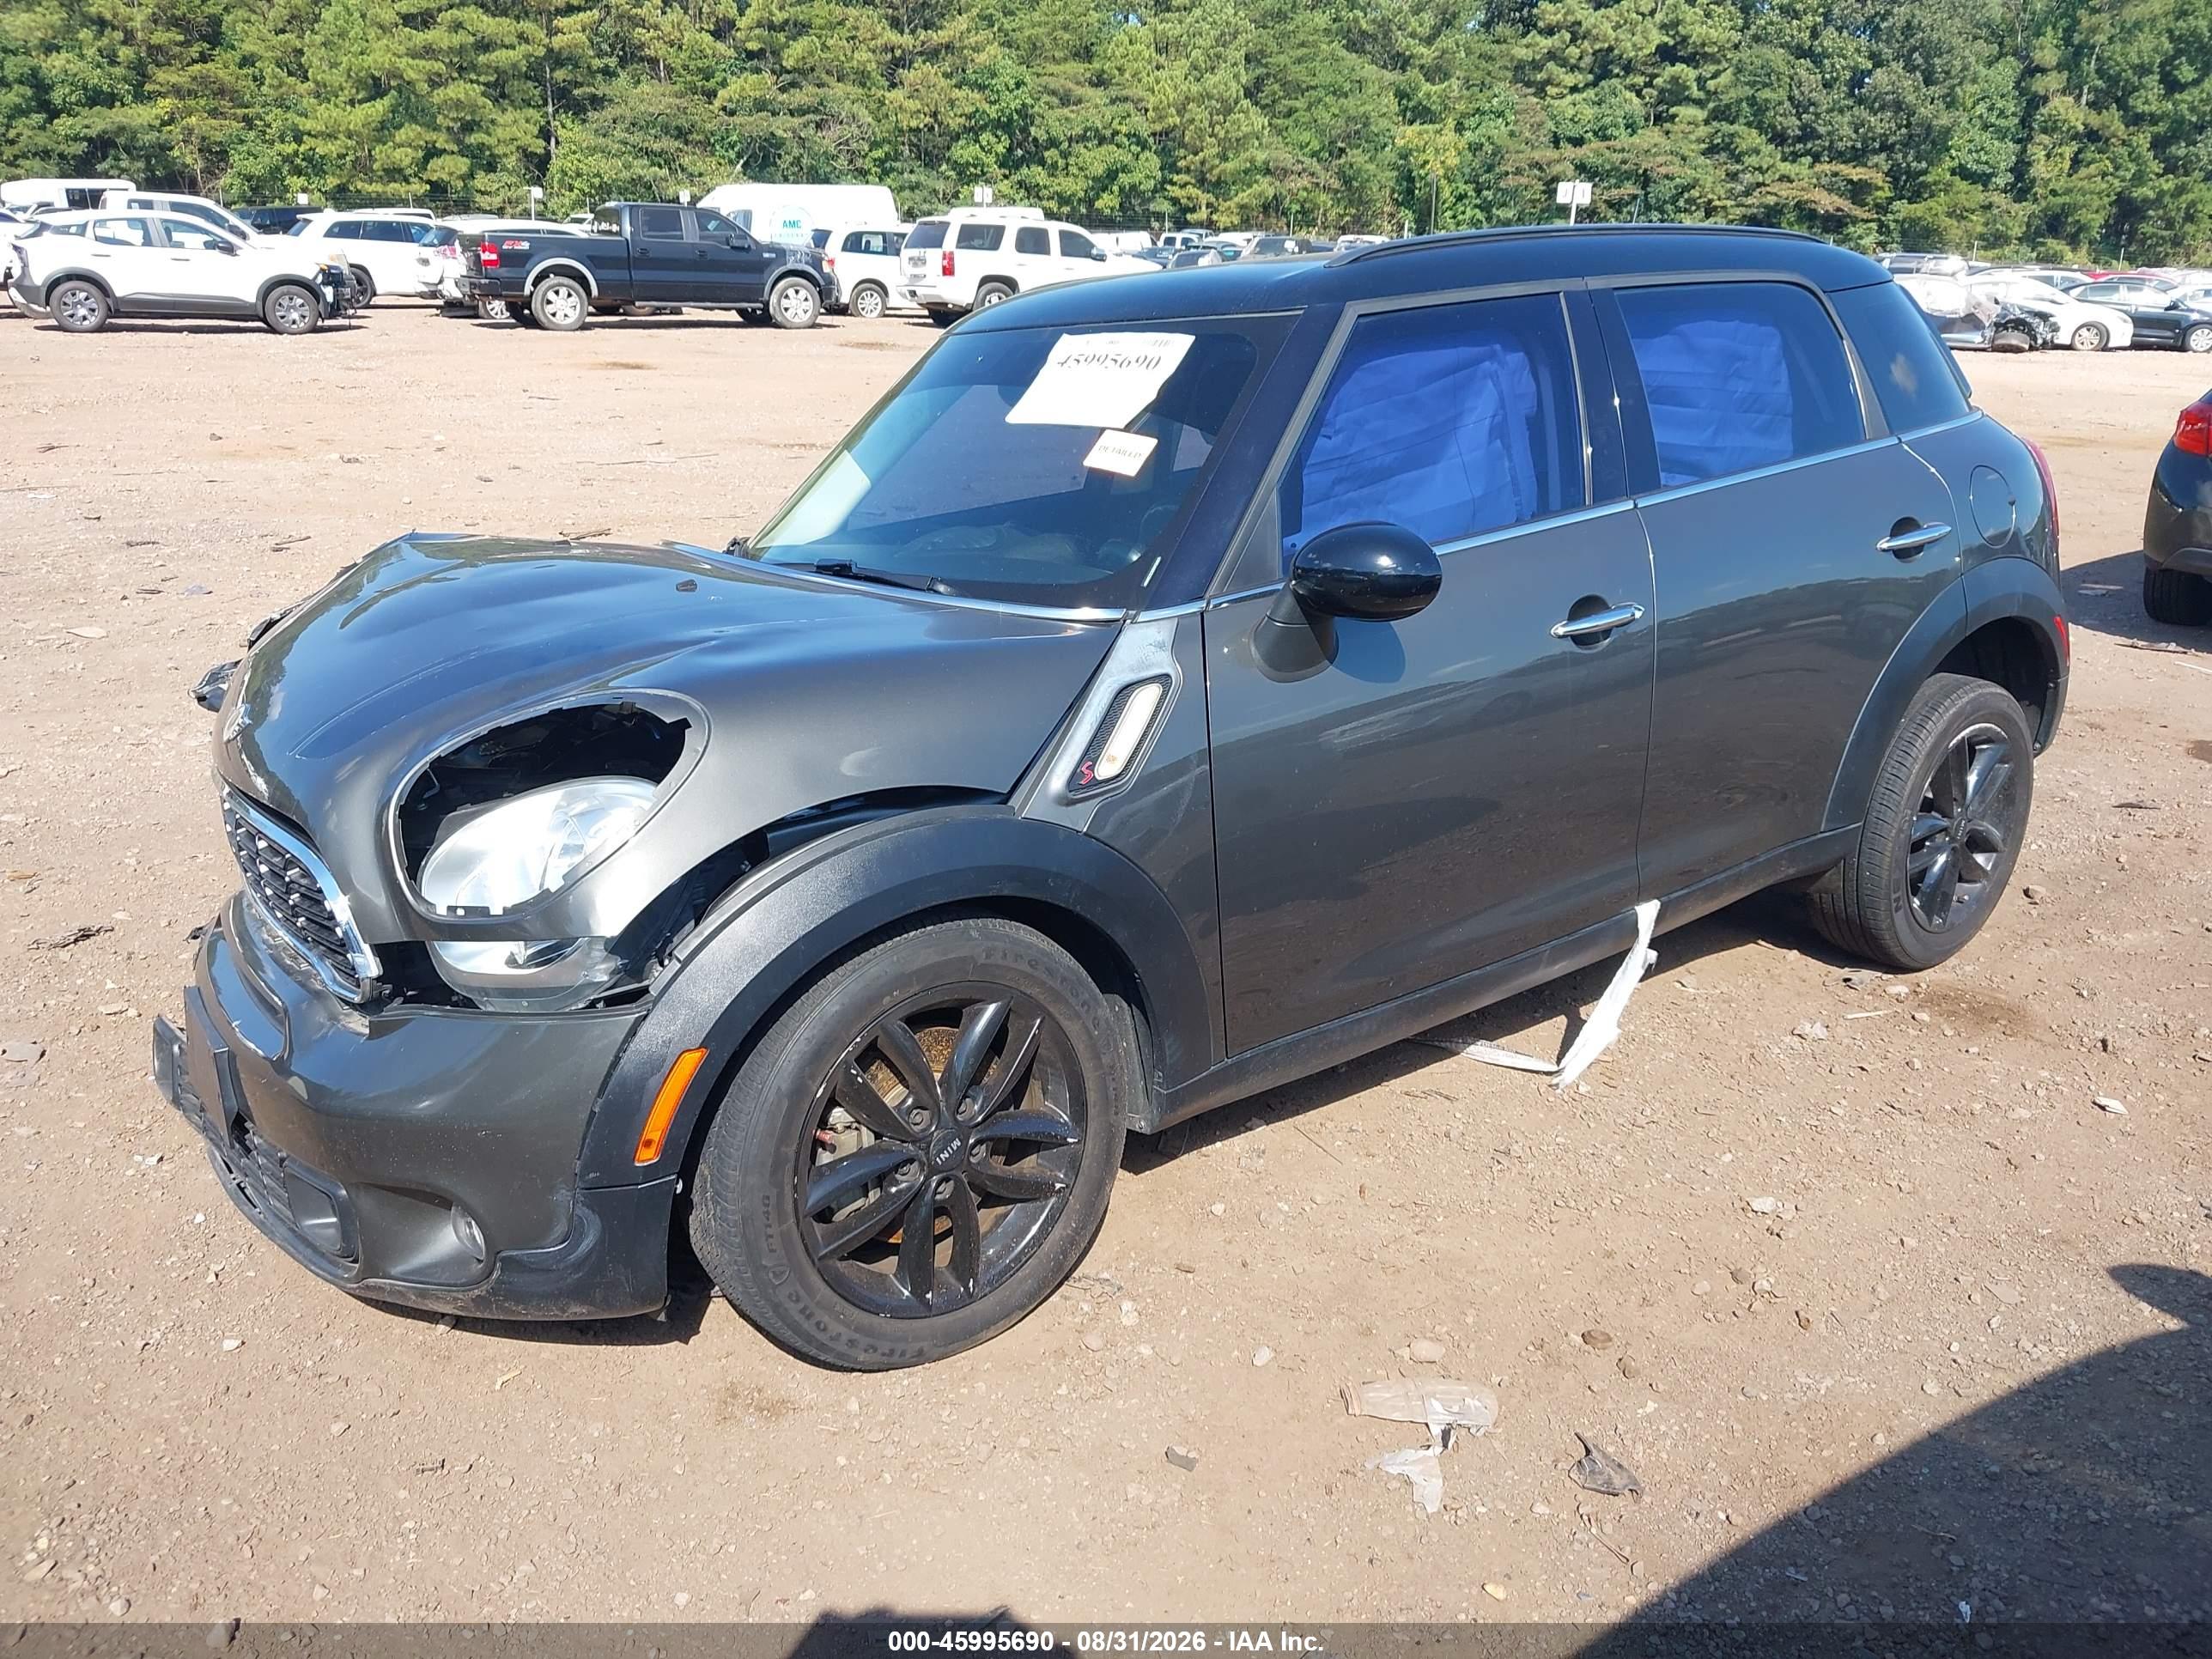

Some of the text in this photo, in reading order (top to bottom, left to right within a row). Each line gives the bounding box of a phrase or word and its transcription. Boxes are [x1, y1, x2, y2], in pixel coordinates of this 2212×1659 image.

[782, 219, 801, 229] AMC
[1079, 761, 1094, 785] S
[936, 1137, 962, 1165] MINI
